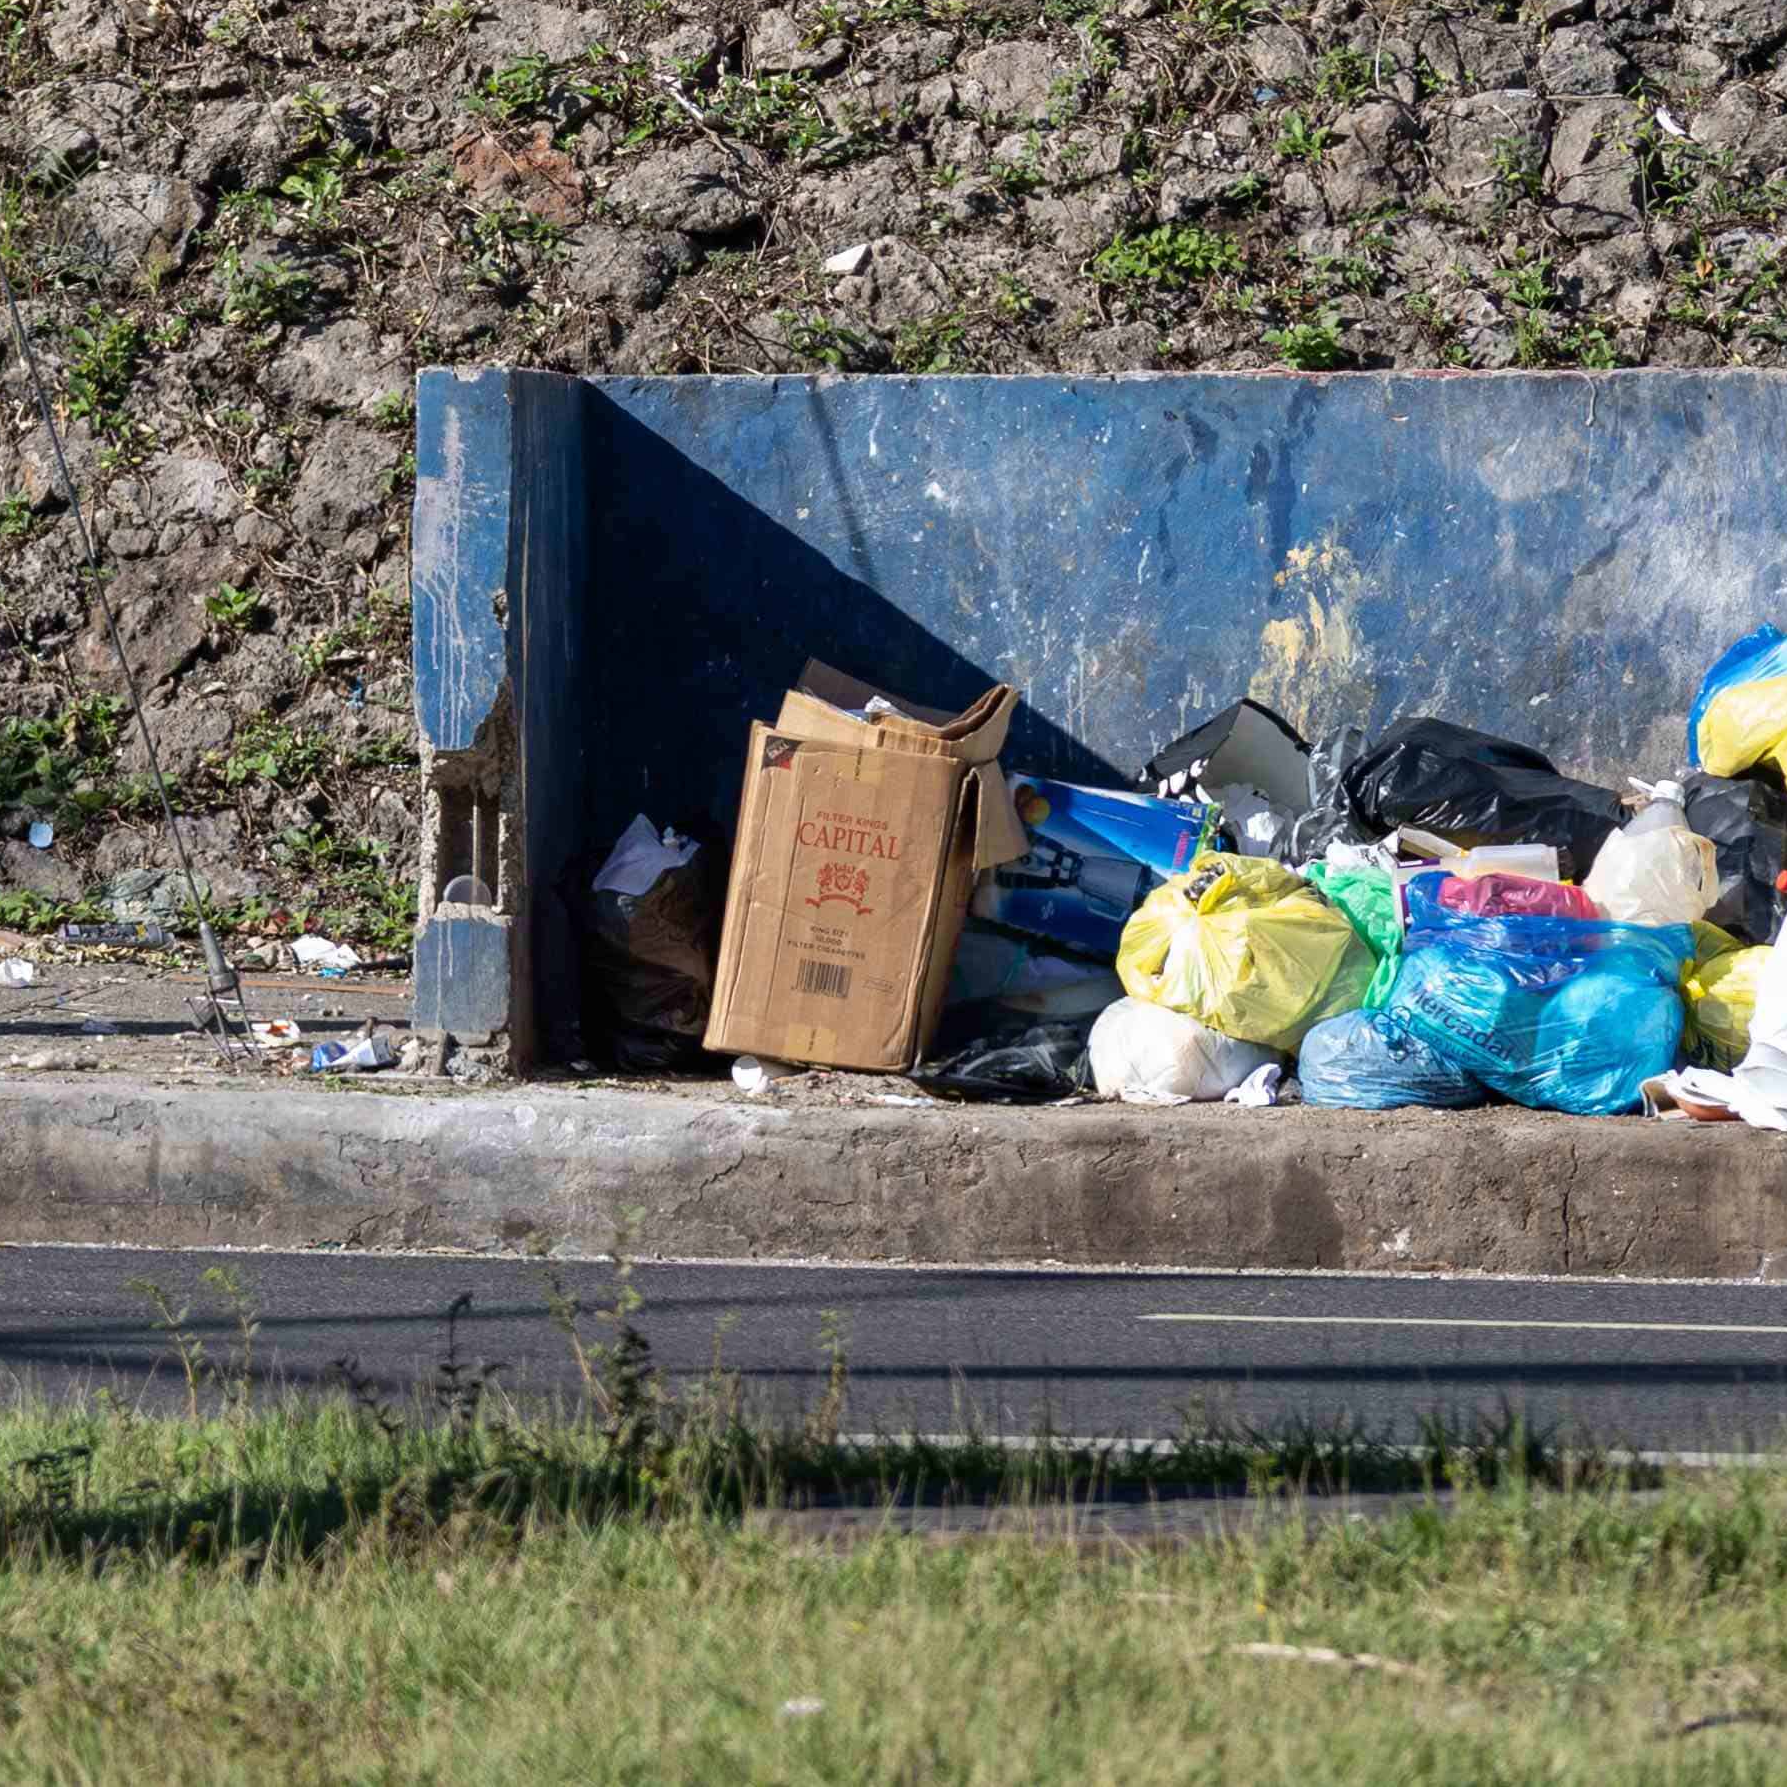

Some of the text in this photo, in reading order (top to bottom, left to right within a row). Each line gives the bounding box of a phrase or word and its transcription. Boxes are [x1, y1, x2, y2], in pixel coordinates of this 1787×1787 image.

[817, 811, 888, 831] FILTER KINGS
[799, 821, 902, 861] CAPITAL
[787, 940, 866, 960] FILTER CIGARETTES
